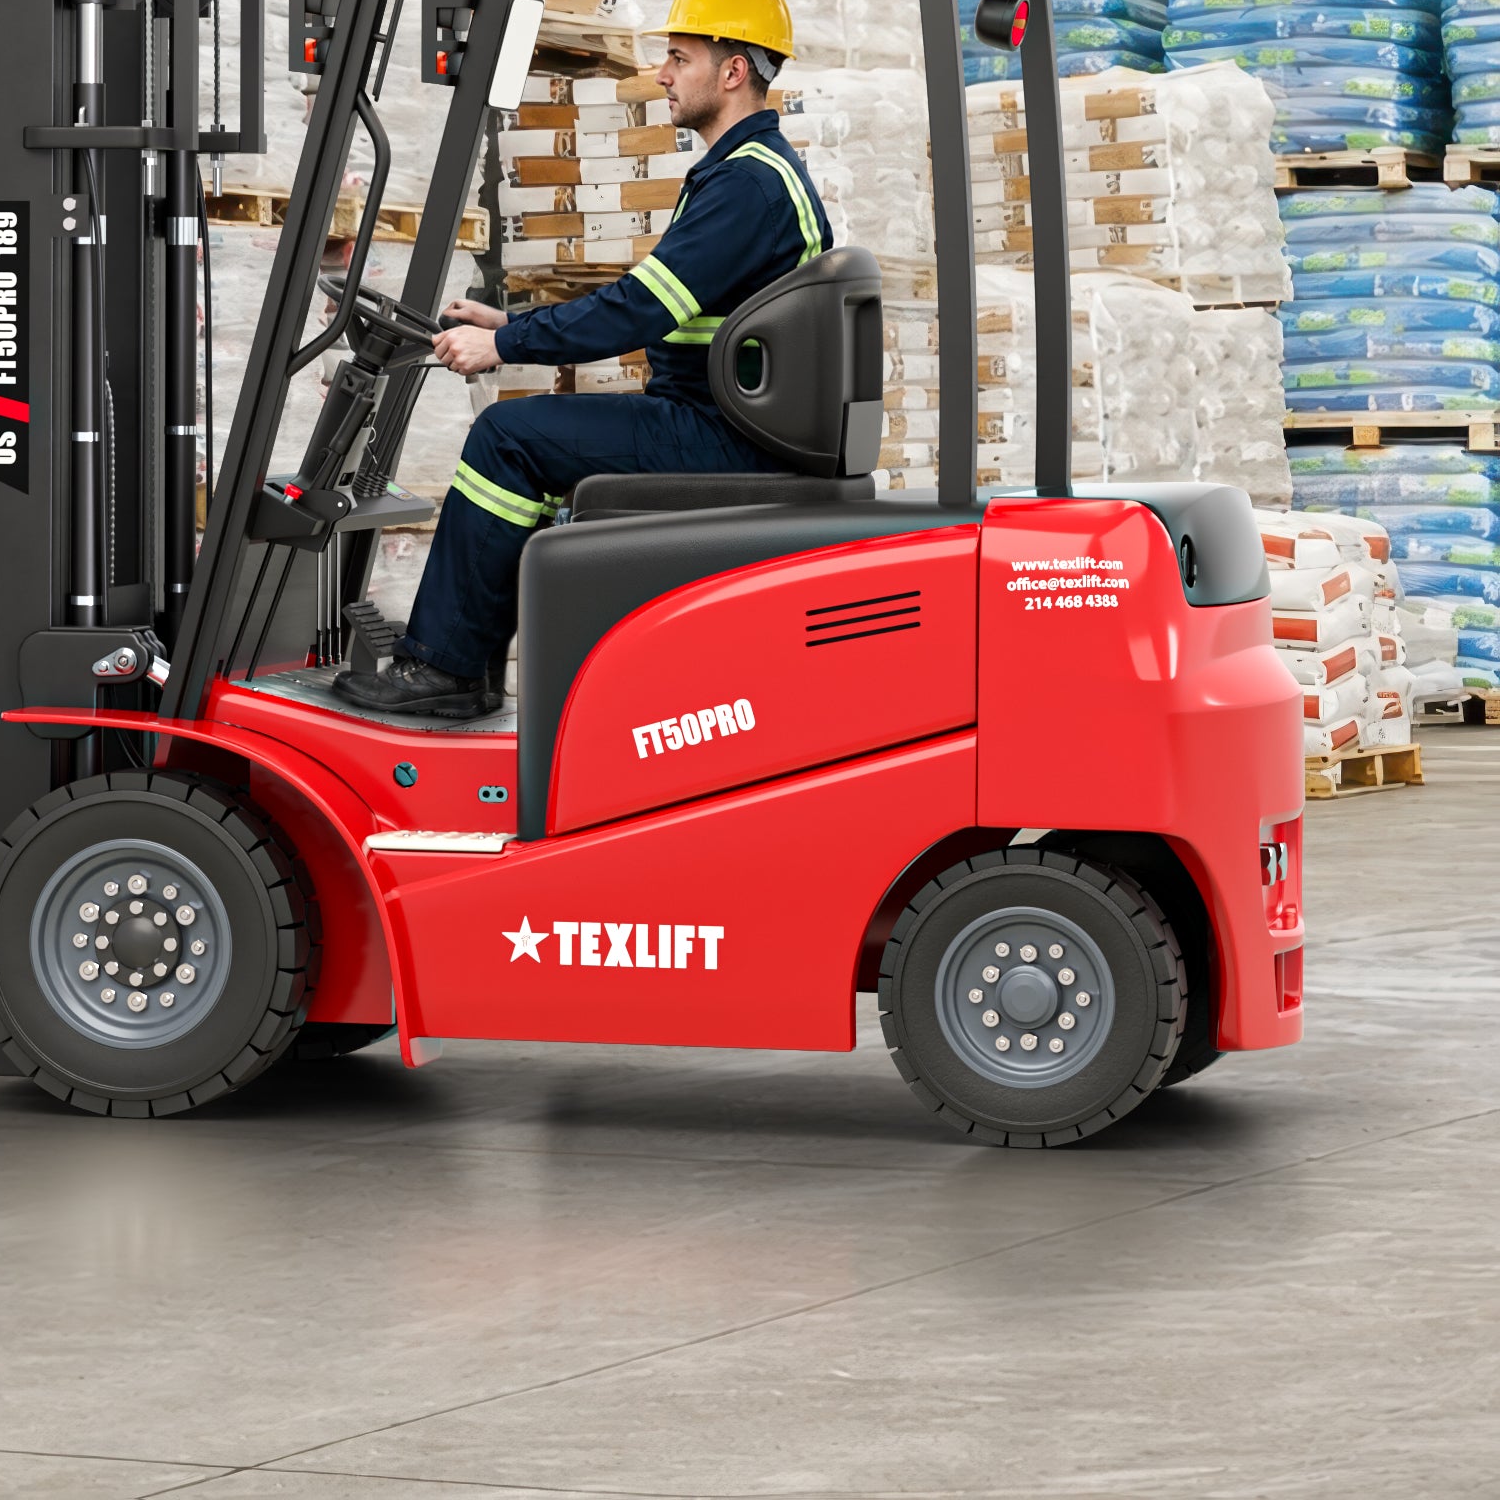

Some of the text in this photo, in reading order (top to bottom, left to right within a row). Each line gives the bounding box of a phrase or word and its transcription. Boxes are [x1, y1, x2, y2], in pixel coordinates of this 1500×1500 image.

[1011, 557, 1123, 571] www.texlift.com
[1007, 575, 1129, 591] office@texlift.com
[1025, 594, 1118, 610] 214 468 4388
[631, 698, 756, 759] FT50PRO
[552, 921, 725, 970] TEXLIFT
